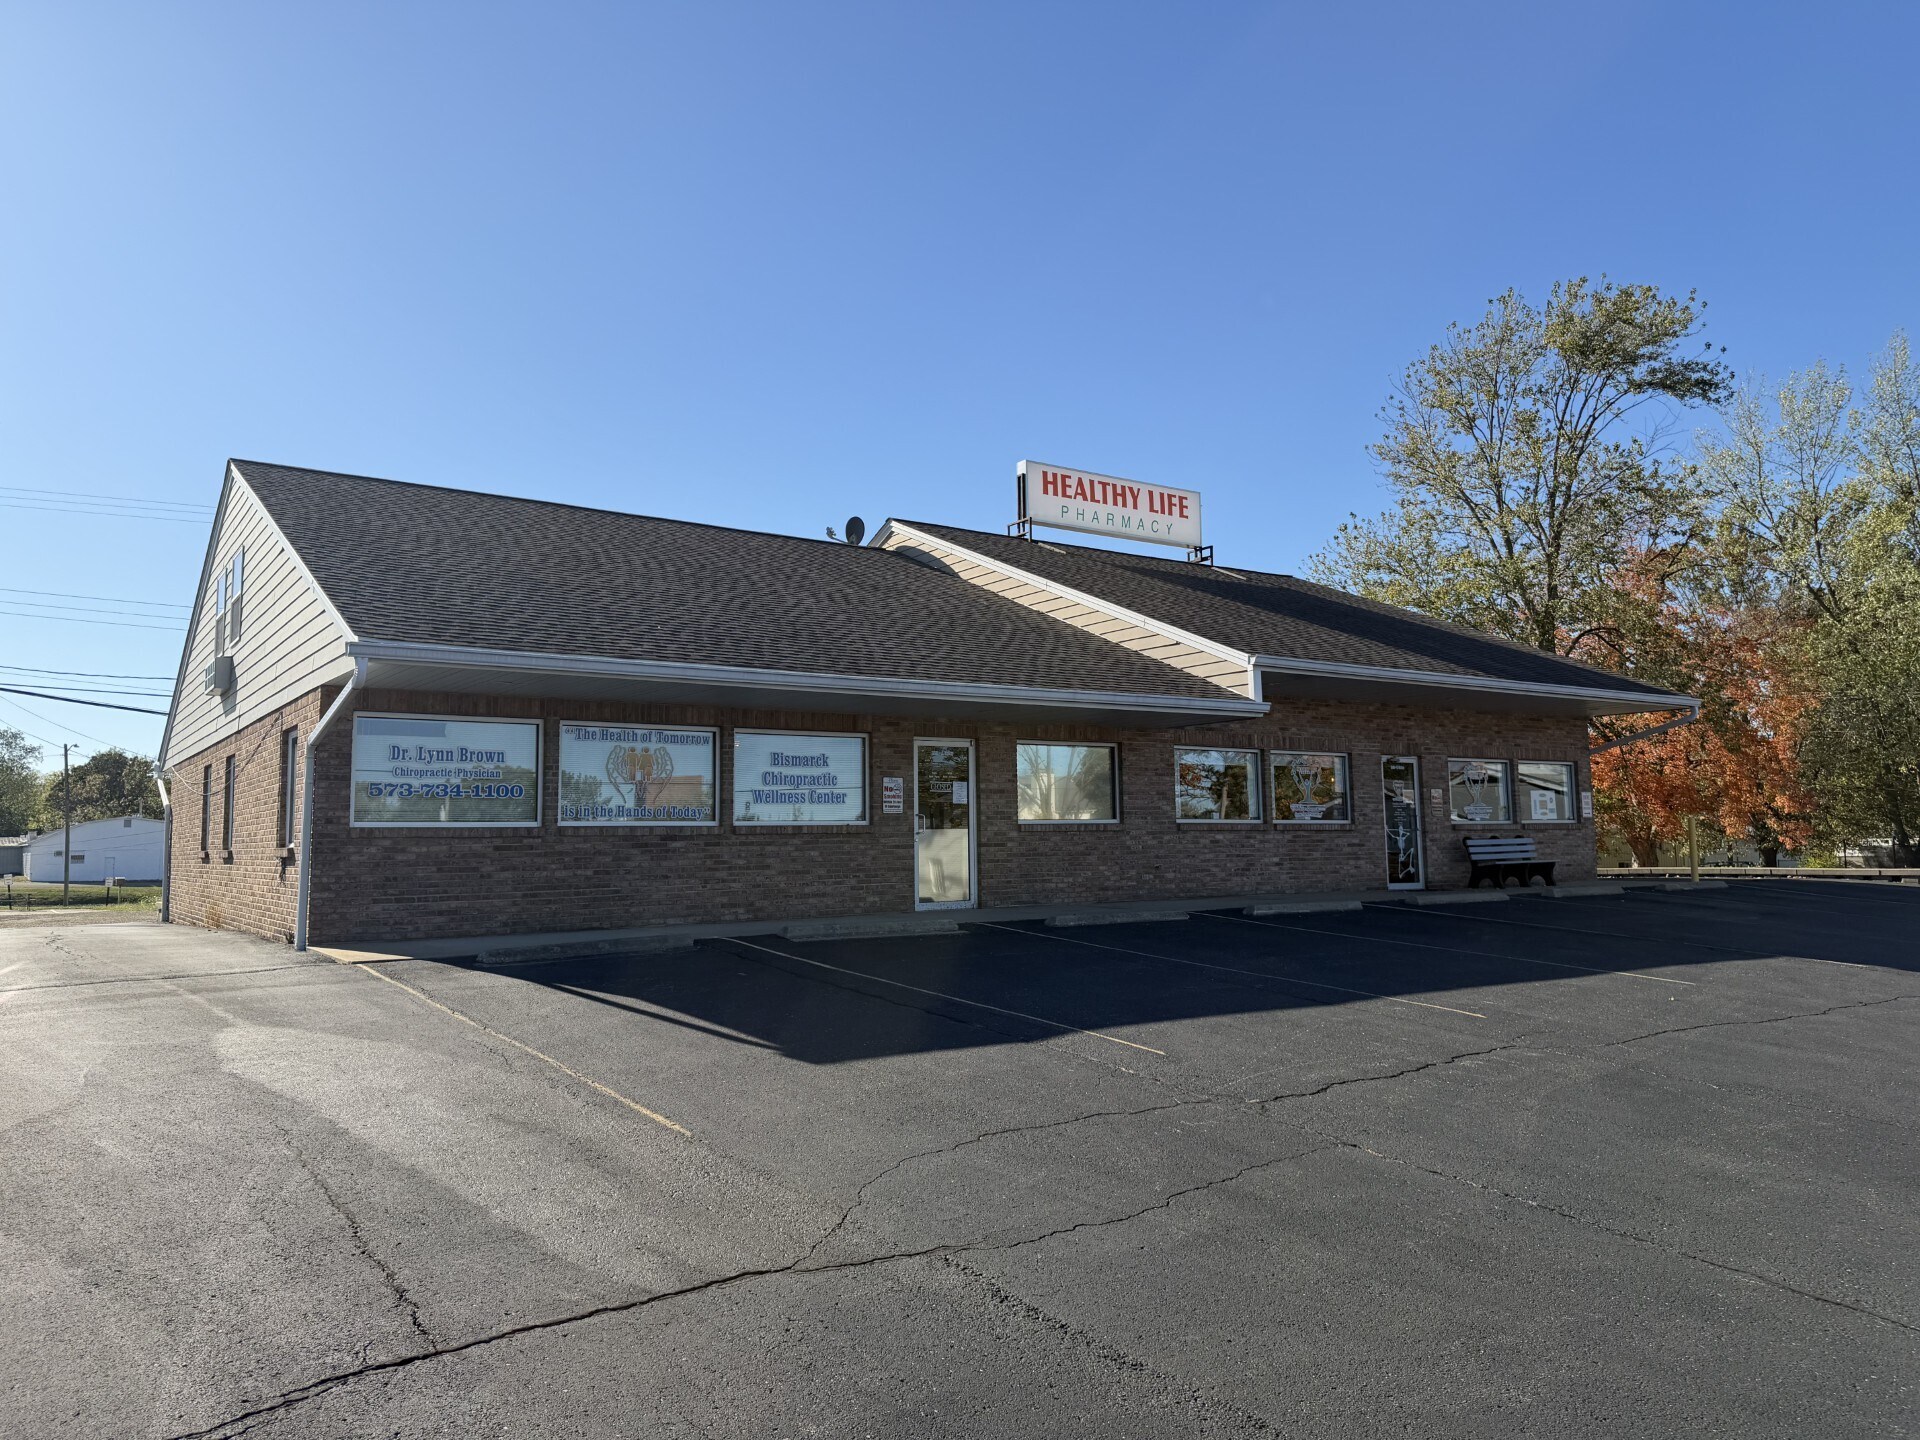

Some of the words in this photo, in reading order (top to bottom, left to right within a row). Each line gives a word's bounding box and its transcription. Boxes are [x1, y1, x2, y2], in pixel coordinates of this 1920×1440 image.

[1042, 470, 1140, 510] HEALTHY
[1147, 490, 1189, 519] LIFE
[1061, 505, 1173, 535] PHARMACY
[600, 729, 638, 742] Health
[640, 730, 652, 743] of
[655, 731, 711, 745] Tomorrow
[390, 745, 412, 761] Dr.
[416, 746, 454, 764] Lynn
[457, 747, 505, 763] Brown
[770, 752, 829, 767] Bismarck
[393, 766, 453, 779] Chiropractic
[455, 768, 501, 779] Physician
[762, 771, 837, 789] Chiropractic
[368, 782, 524, 798] 573-734-1100
[752, 789, 805, 804] Wellness
[808, 790, 847, 804] Center
[564, 805, 575, 817] is
[579, 805, 591, 818] in
[595, 806, 613, 818] the
[616, 806, 653, 818] Hands
[656, 806, 667, 818] of
